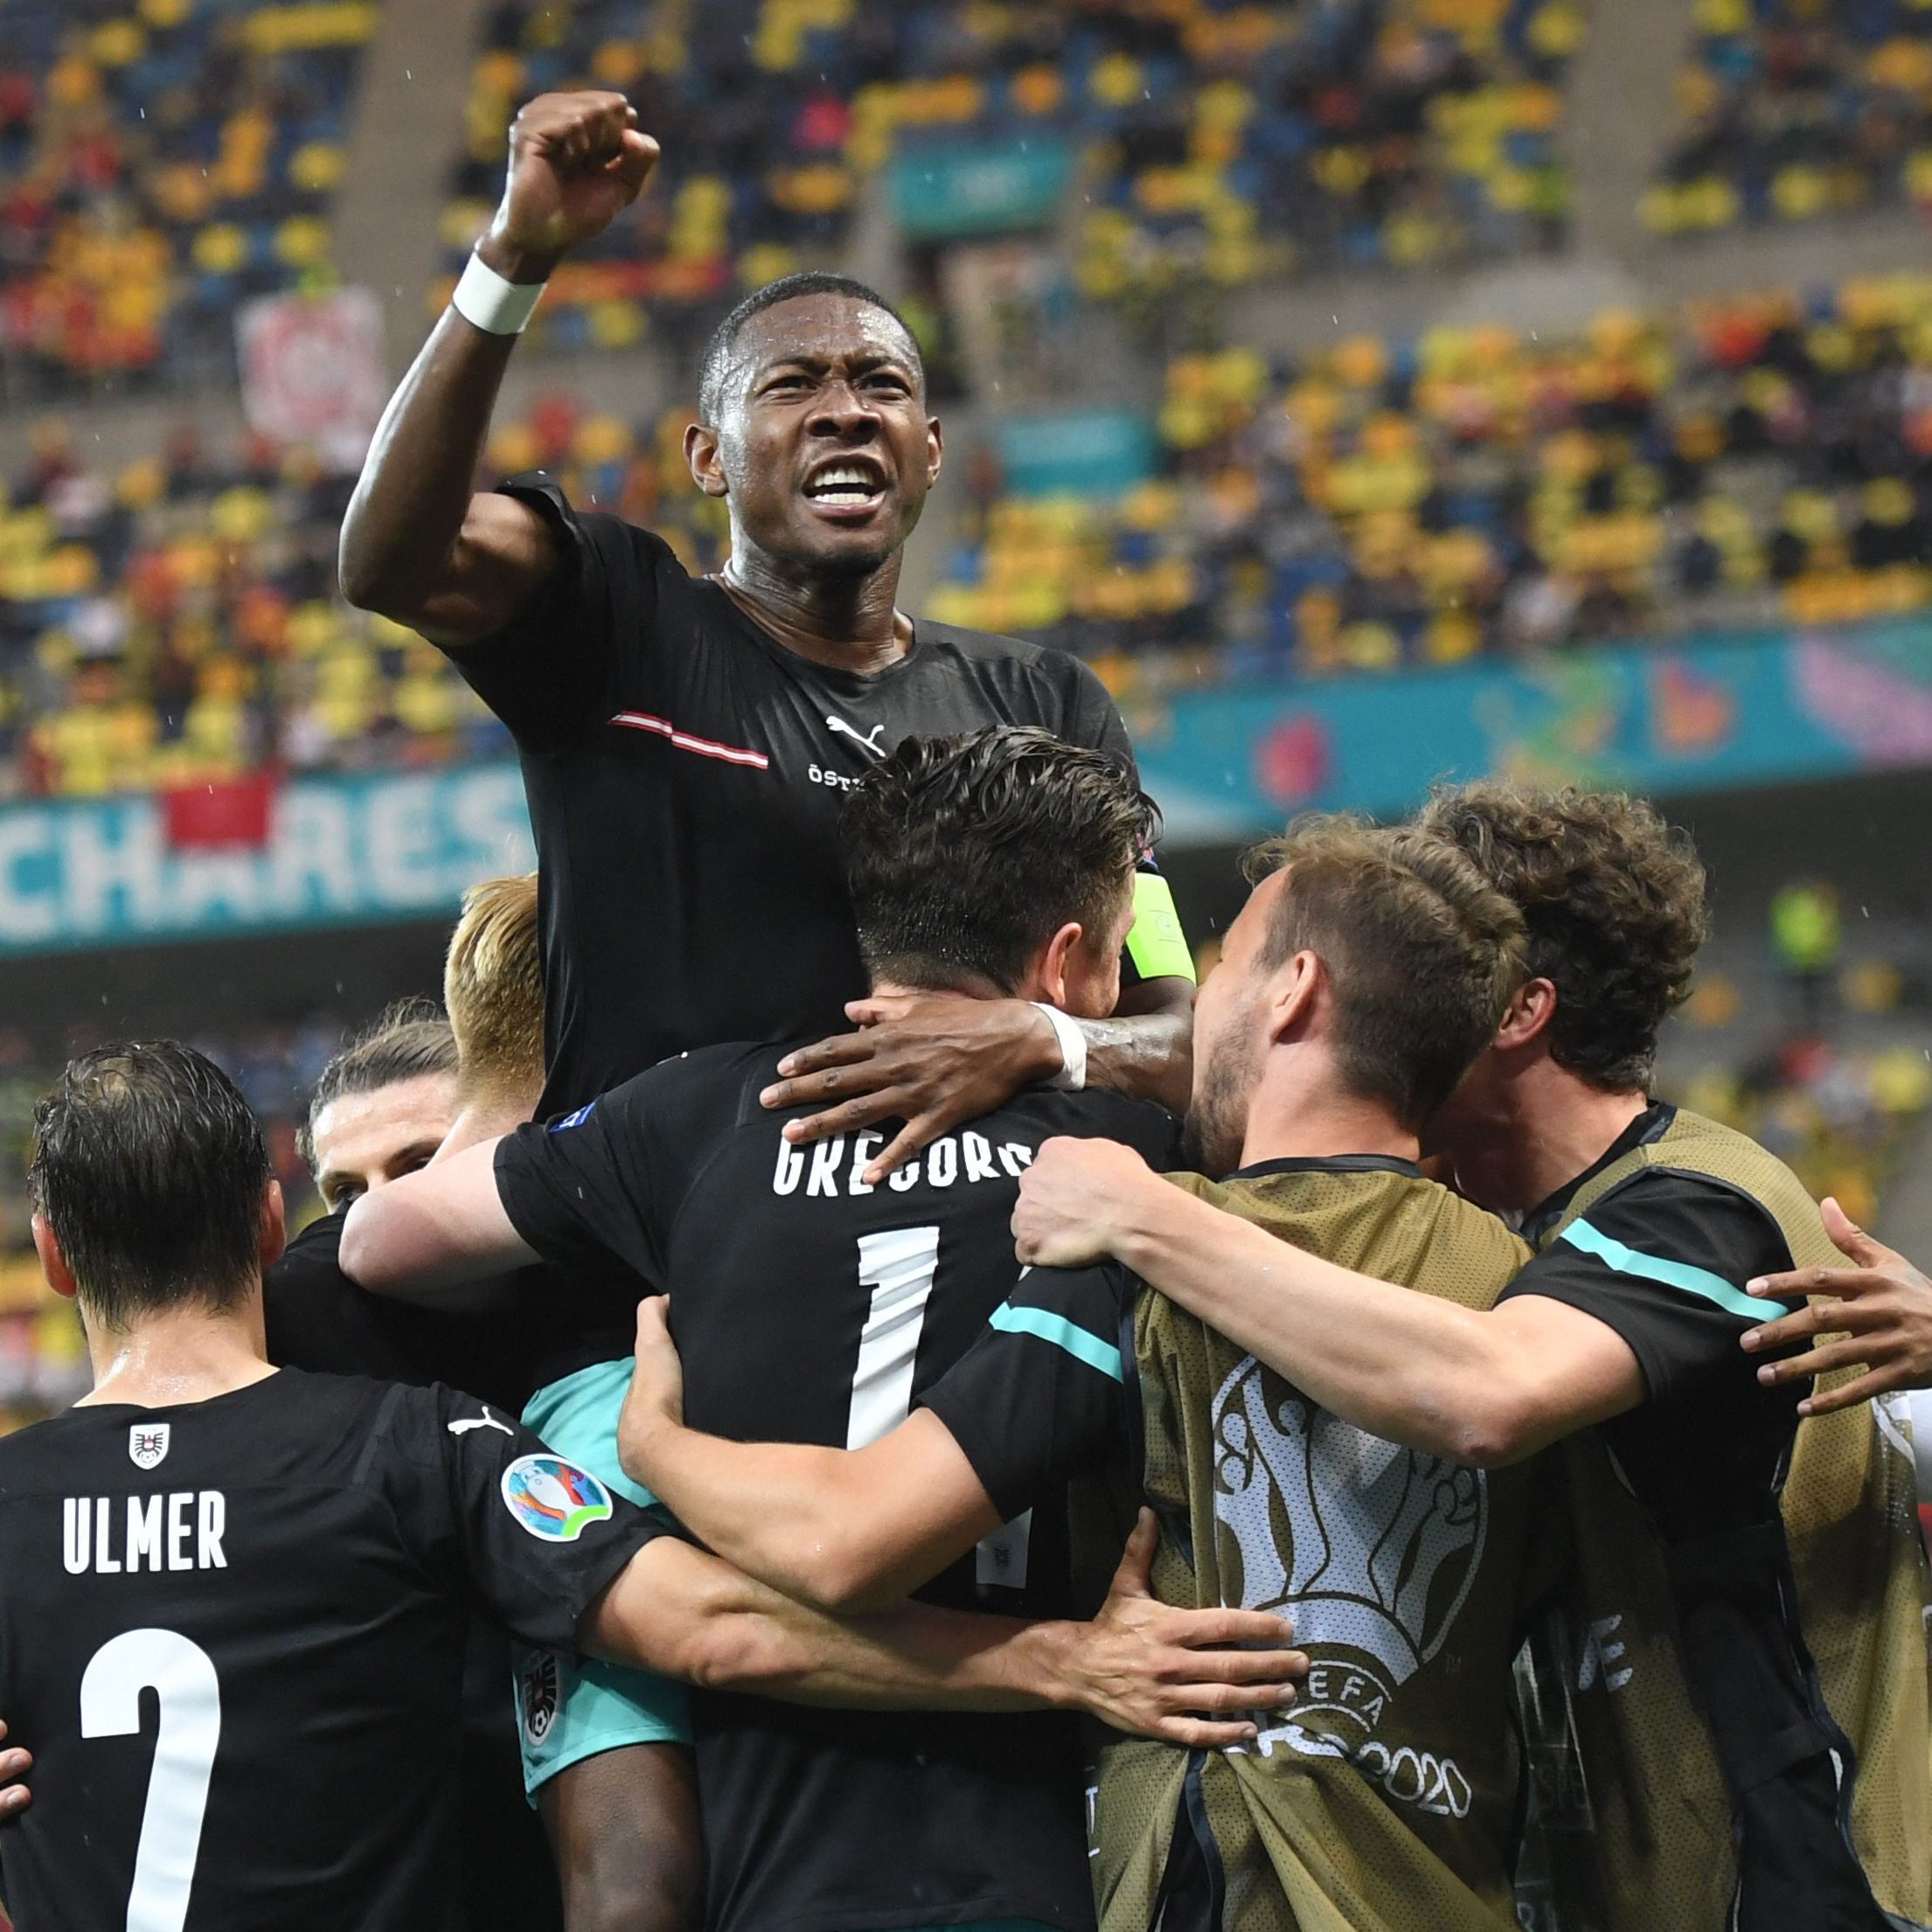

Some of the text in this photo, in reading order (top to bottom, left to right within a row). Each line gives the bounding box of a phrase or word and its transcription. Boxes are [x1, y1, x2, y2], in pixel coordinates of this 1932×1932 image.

[63, 1491, 228, 1574] ULMER
[1292, 1670, 1384, 1727] EFA
[80, 1628, 221, 1932] 2
